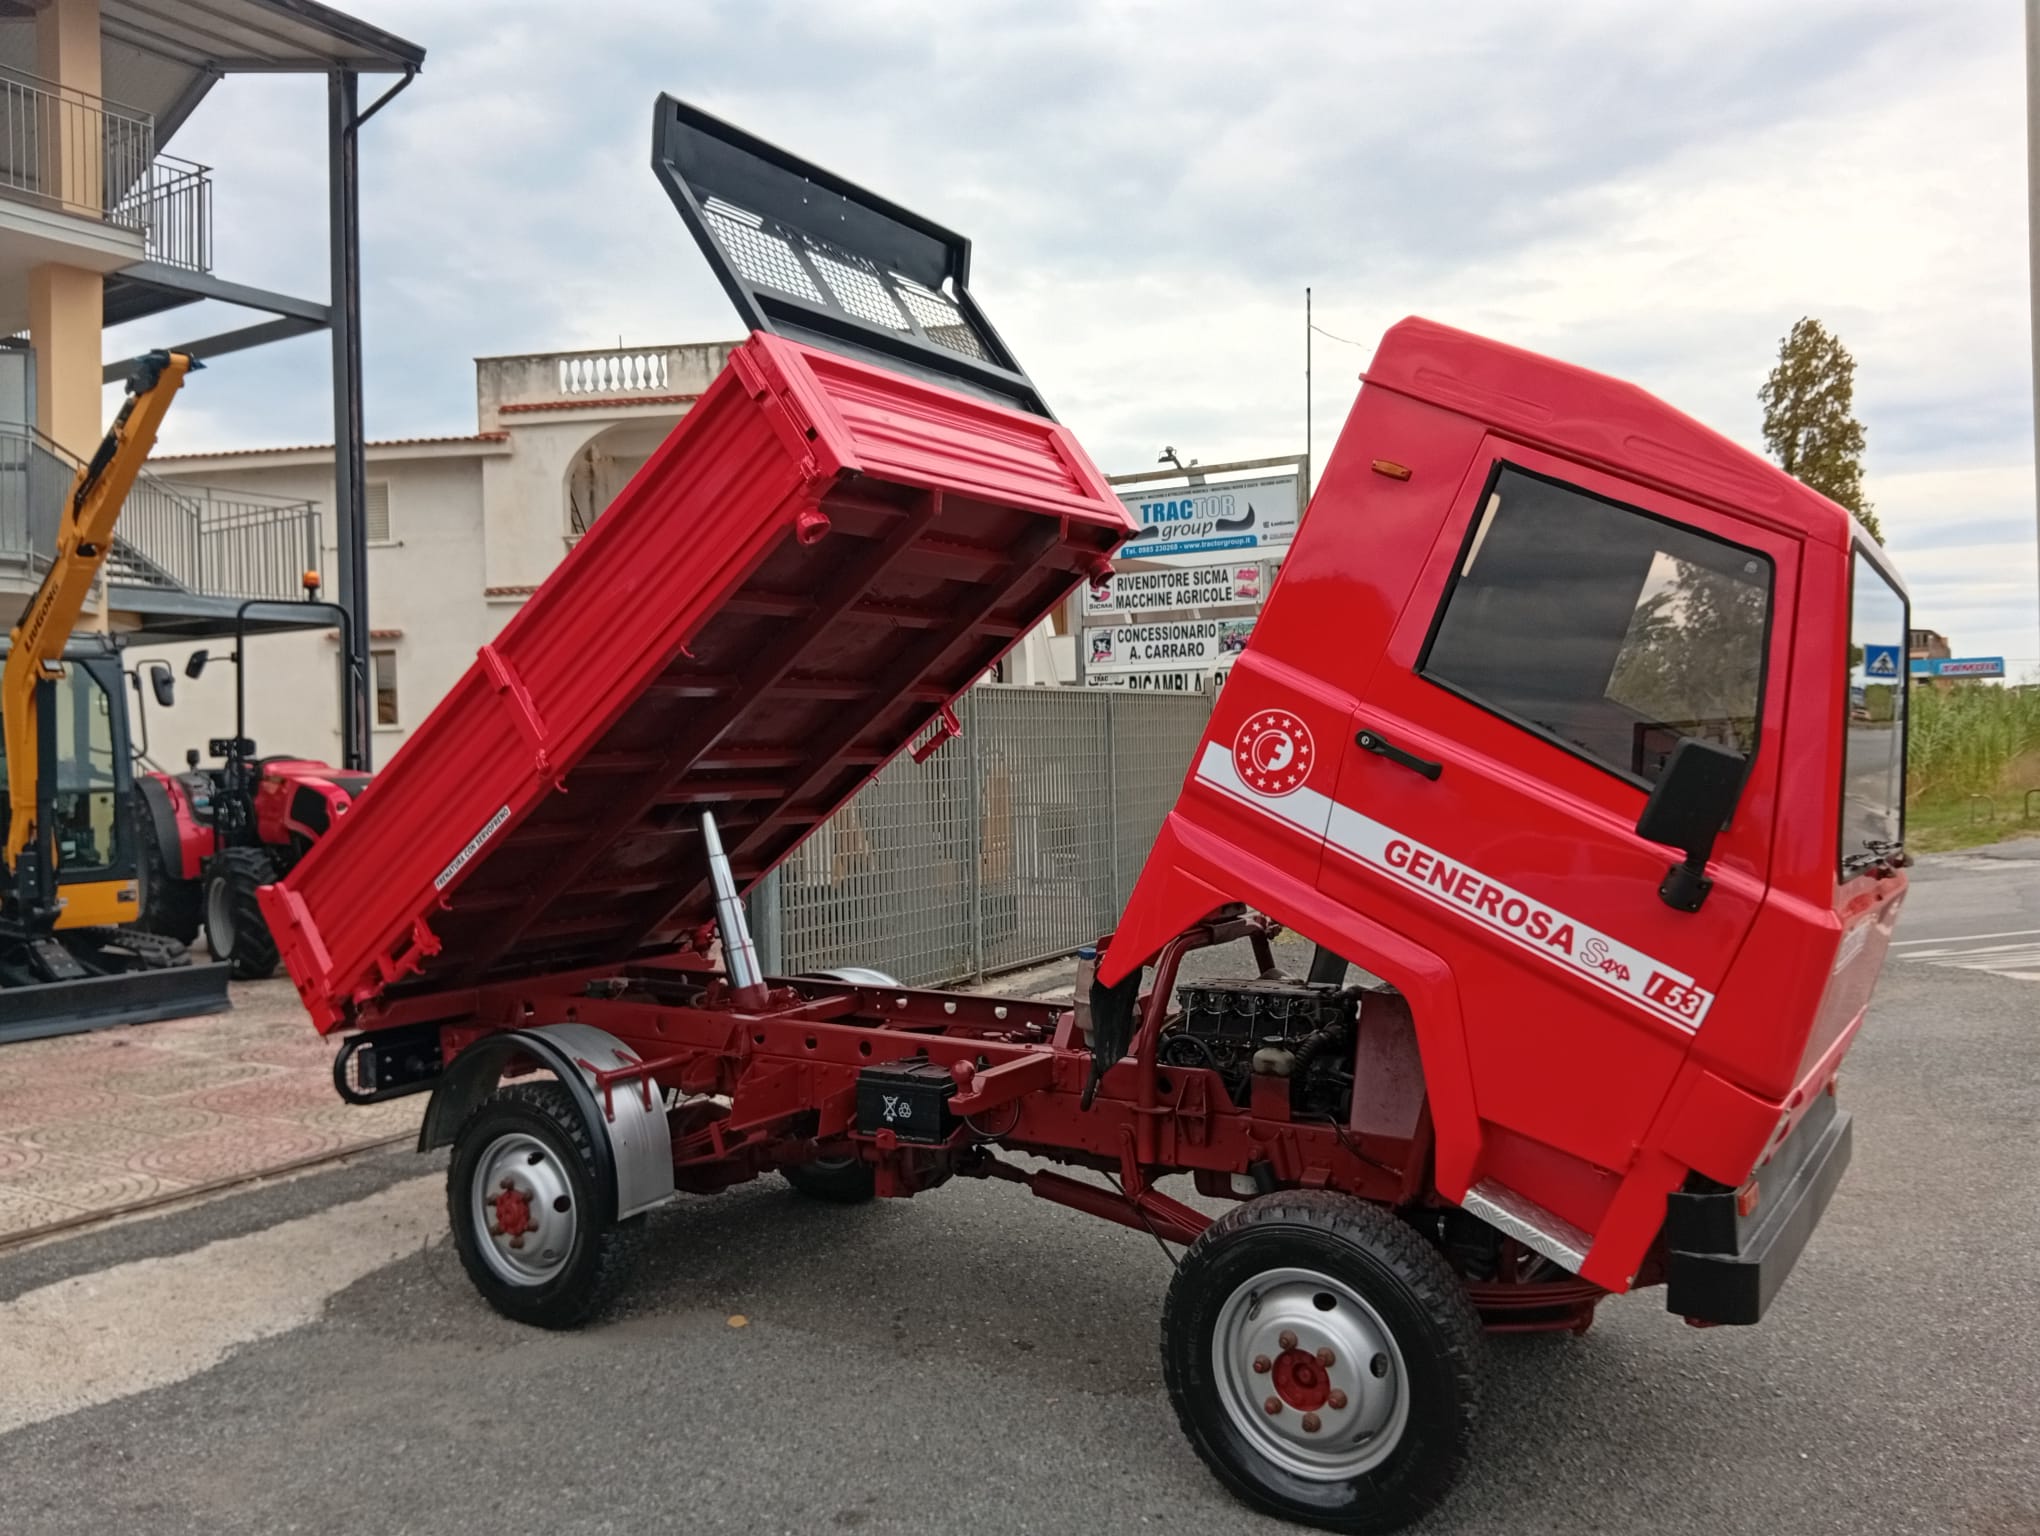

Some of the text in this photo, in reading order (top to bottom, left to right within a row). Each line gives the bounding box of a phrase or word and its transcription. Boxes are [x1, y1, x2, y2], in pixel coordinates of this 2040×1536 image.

[1140, 495, 1235, 524] TRACTOR
[1161, 521, 1213, 541] group
[1117, 569, 1229, 592] RIVENDITORE SICMA
[1116, 586, 1233, 609] MACCHINE AGRICOLE
[24, 581, 59, 653] LIUGONG
[1117, 623, 1217, 643] CONCESSIONARIO
[1129, 642, 1205, 660] A. CARRARO
[1384, 839, 1574, 956] GENEROSA
[1664, 985, 1700, 1015] 53
